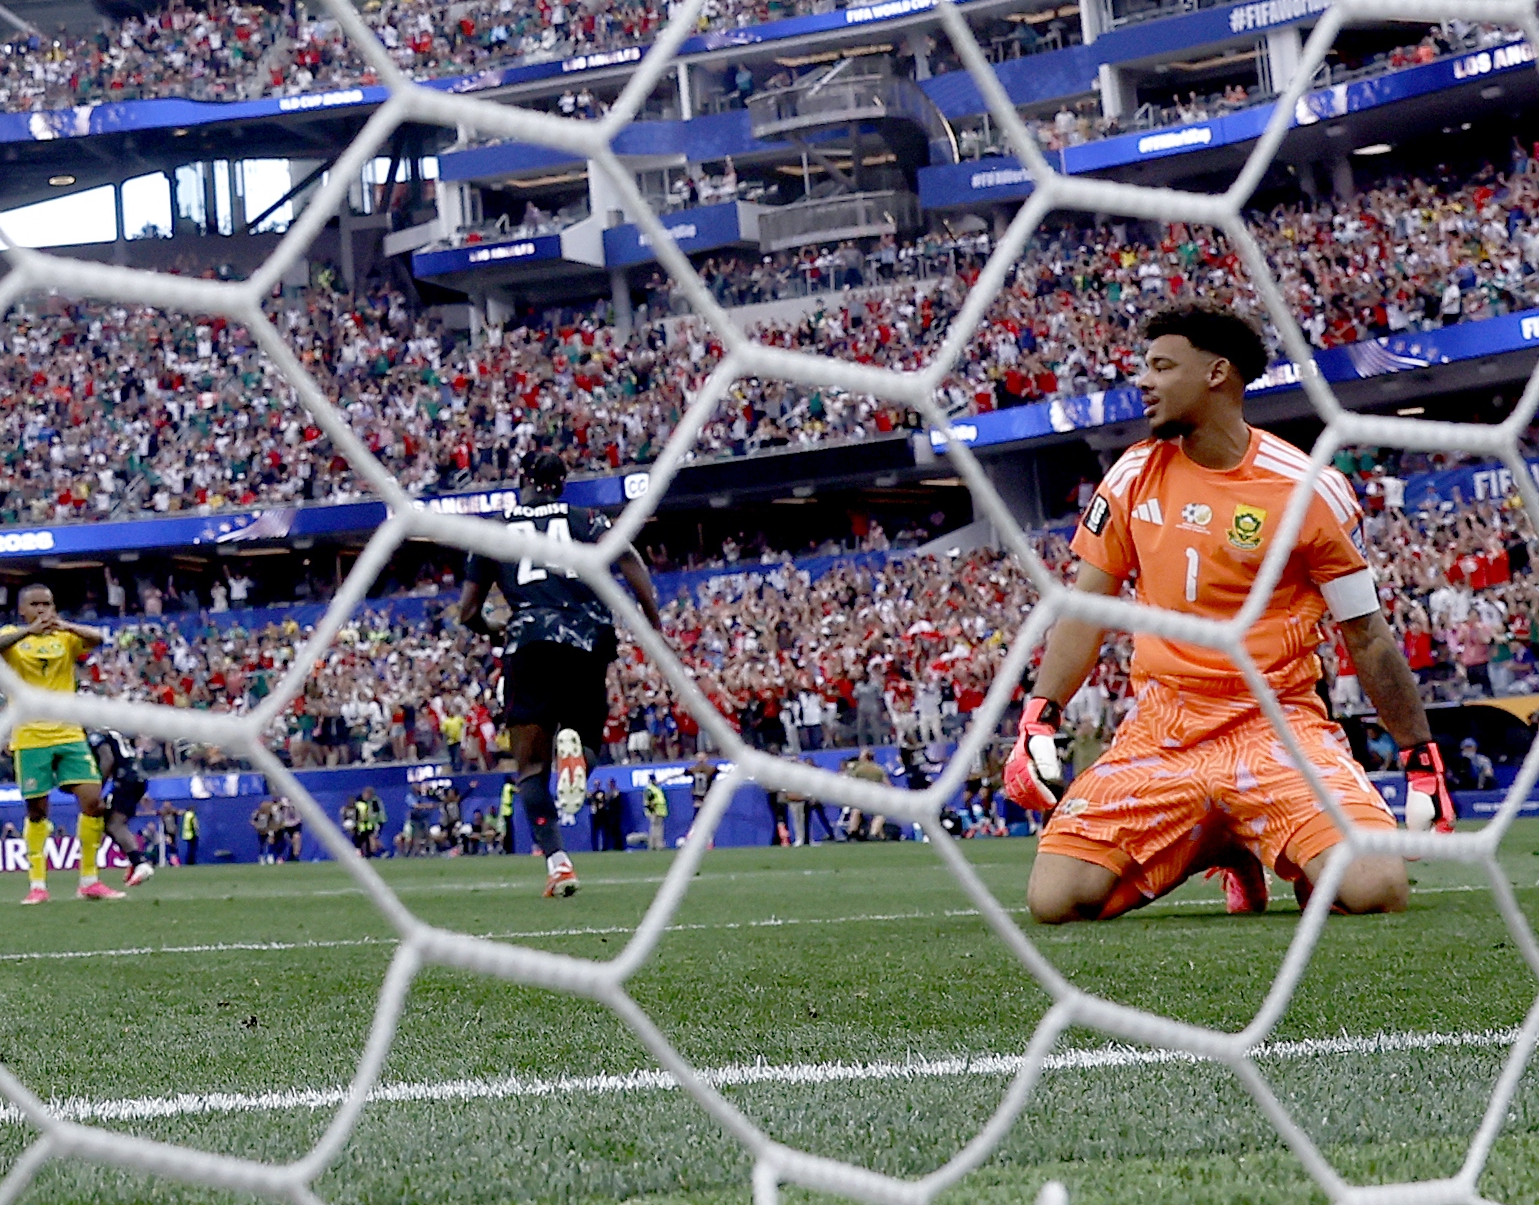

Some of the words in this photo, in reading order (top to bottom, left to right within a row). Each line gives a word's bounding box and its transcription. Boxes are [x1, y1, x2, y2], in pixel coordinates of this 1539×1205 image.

[1454, 52, 1492, 80] LOS
[428, 492, 517, 516] ANGELES
[1186, 547, 1199, 602] 1
